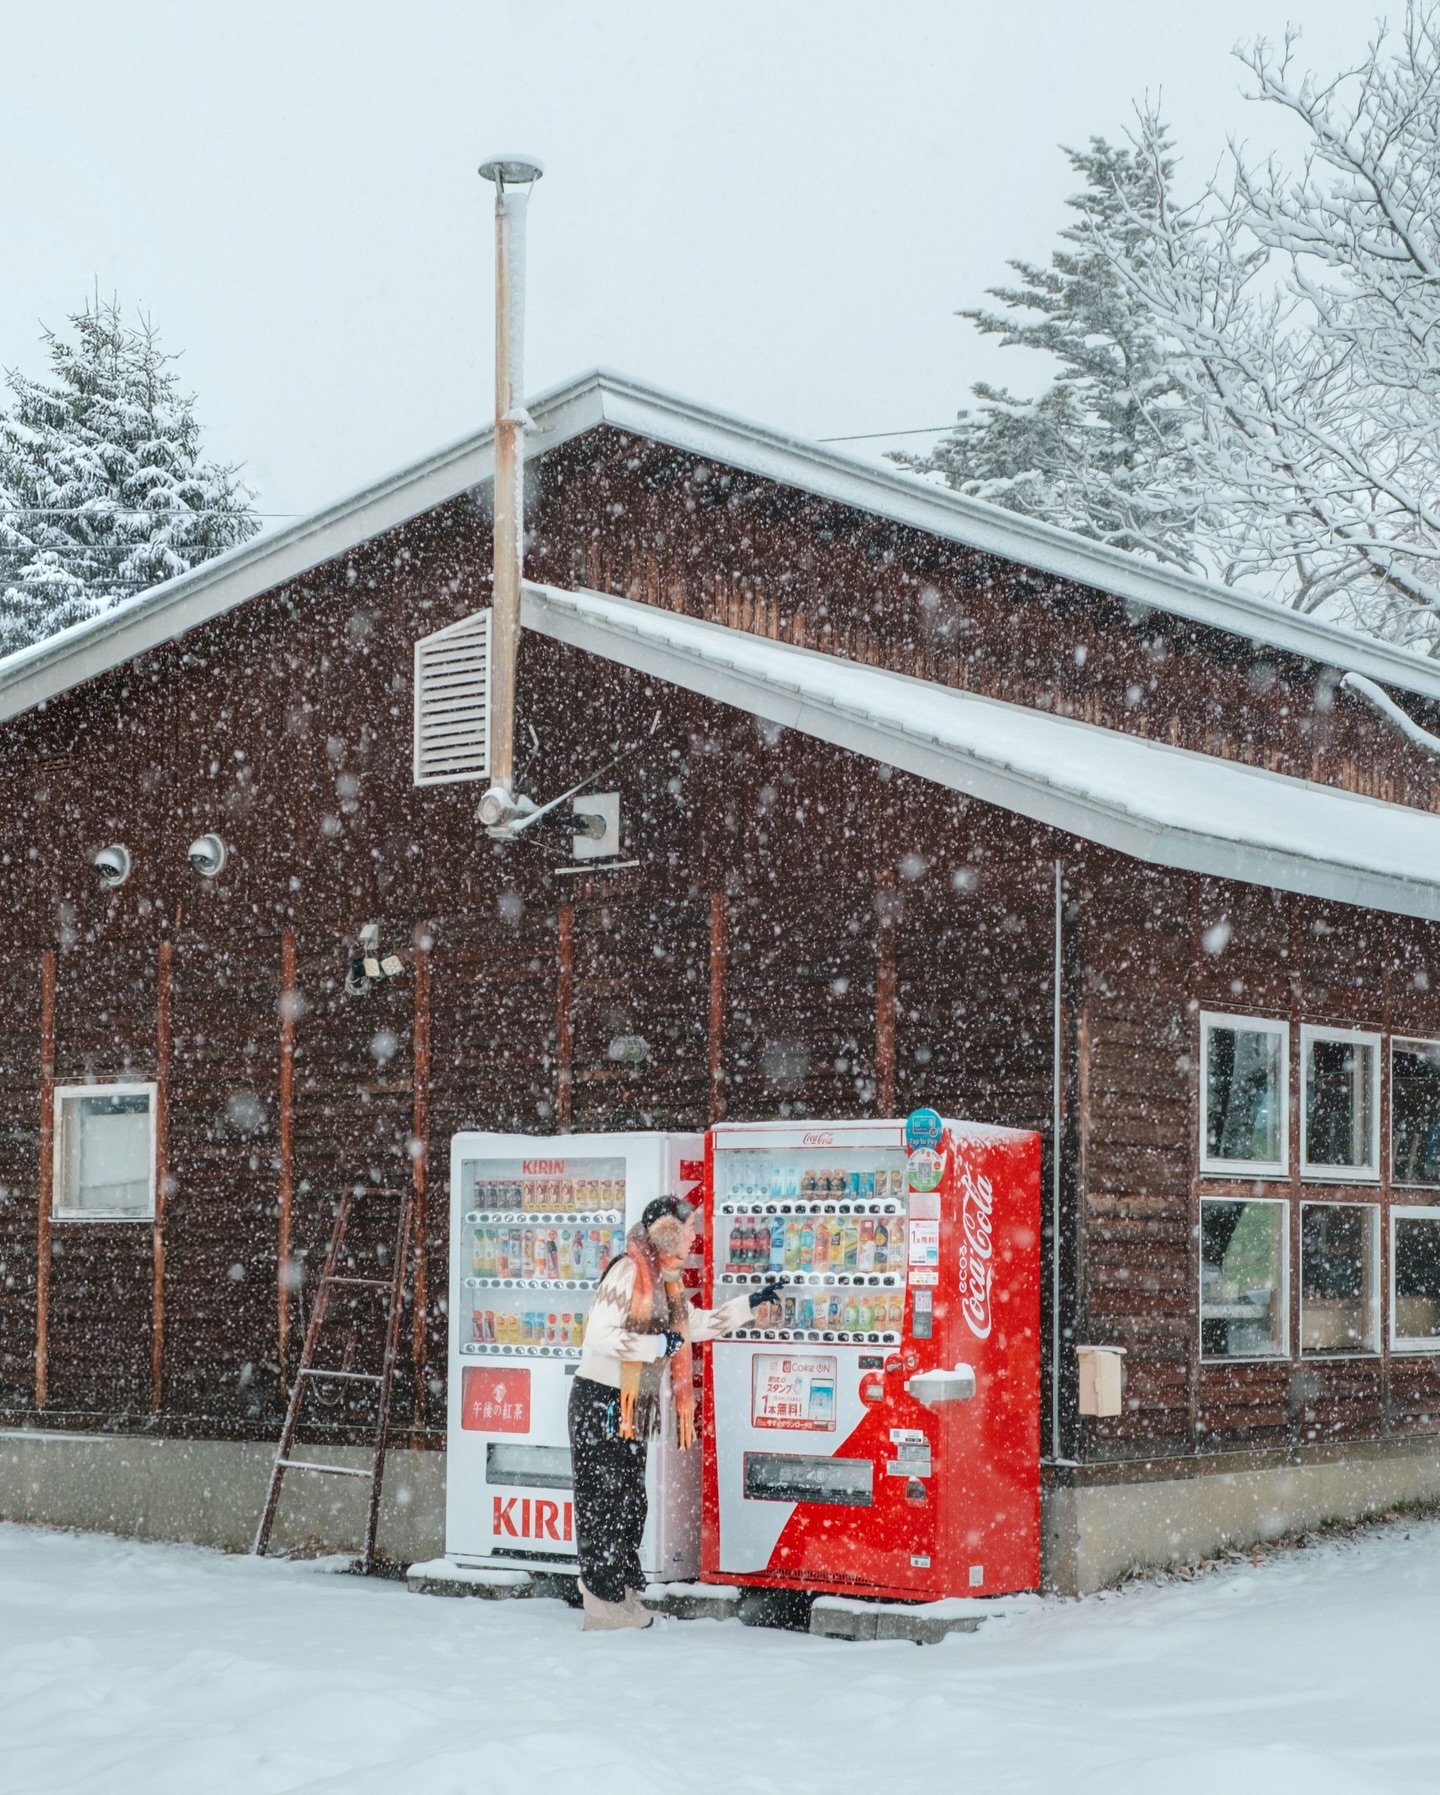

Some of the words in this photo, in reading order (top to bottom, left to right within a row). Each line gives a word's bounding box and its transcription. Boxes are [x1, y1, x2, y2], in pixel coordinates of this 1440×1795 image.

[522, 1159, 564, 1174] KIRIN
[961, 1163, 993, 1339] Coca-Cola
[792, 1363, 815, 1373] Coke
[472, 1400, 524, 1421] 午後の紅茶
[493, 1496, 573, 1542] KIRI
